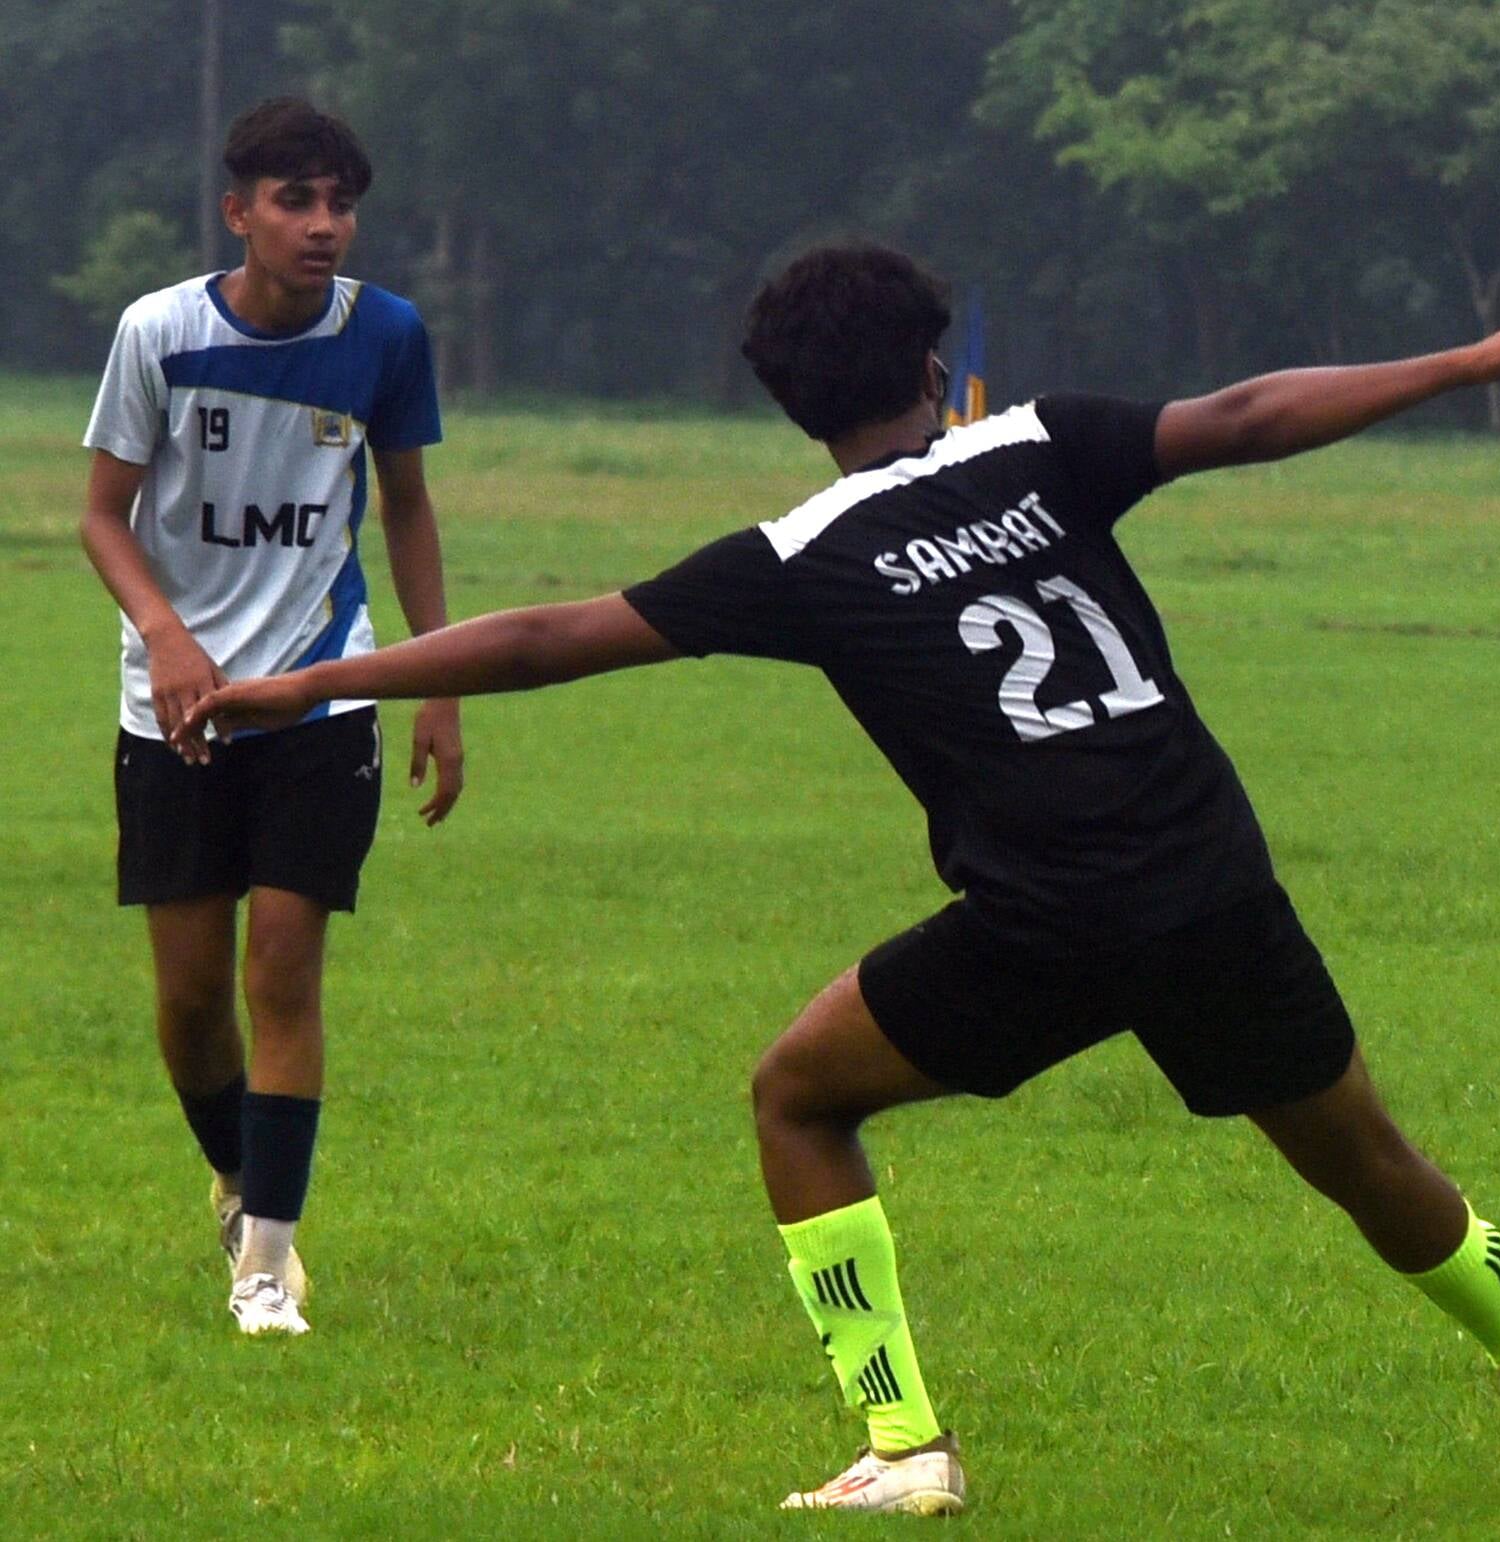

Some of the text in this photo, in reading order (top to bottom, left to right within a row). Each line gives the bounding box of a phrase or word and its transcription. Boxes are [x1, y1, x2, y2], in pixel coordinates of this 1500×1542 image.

[198, 407, 229, 451] 19
[874, 492, 1066, 595] SAMRAT
[958, 574, 1165, 742] 21
